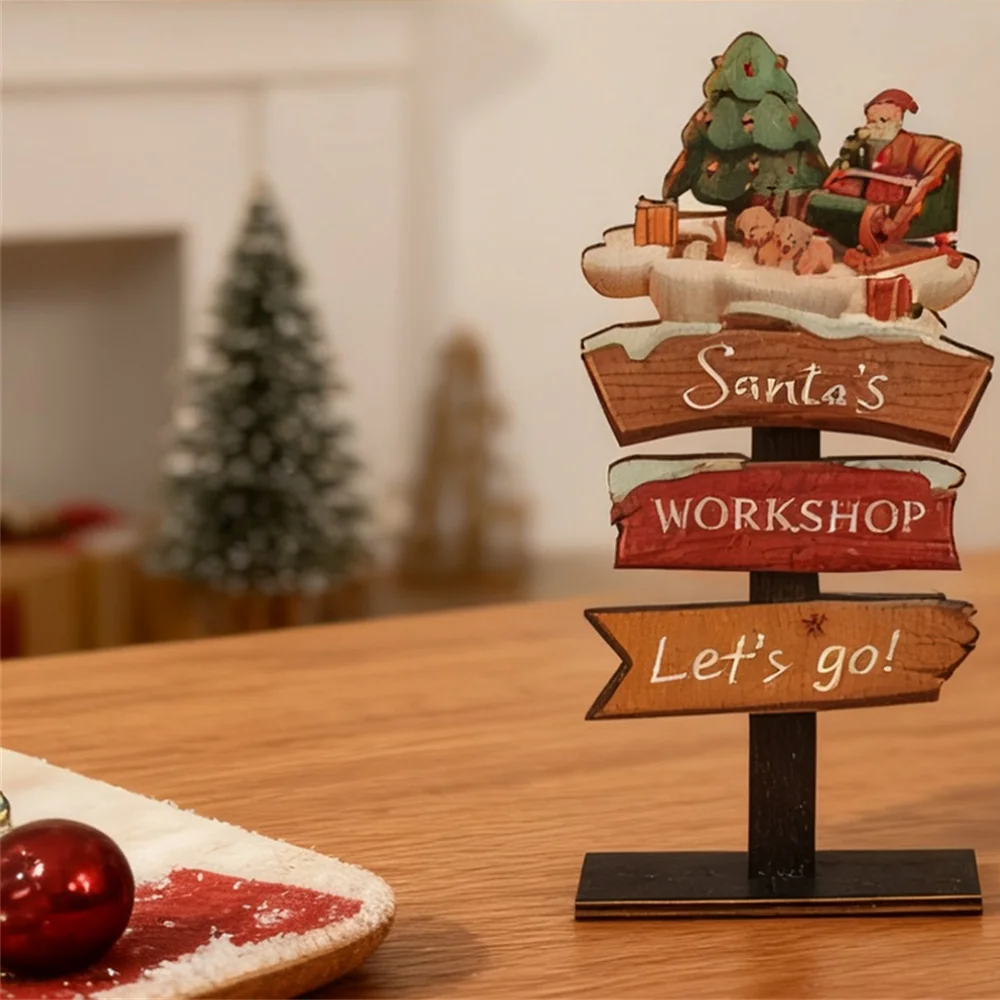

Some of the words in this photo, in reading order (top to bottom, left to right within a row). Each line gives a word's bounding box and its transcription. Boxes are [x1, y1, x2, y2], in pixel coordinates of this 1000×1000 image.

[682, 342, 889, 414] Santa's
[650, 496, 927, 534] WORKSHOP
[650, 632, 794, 685] Let's
[813, 630, 901, 692] go!
